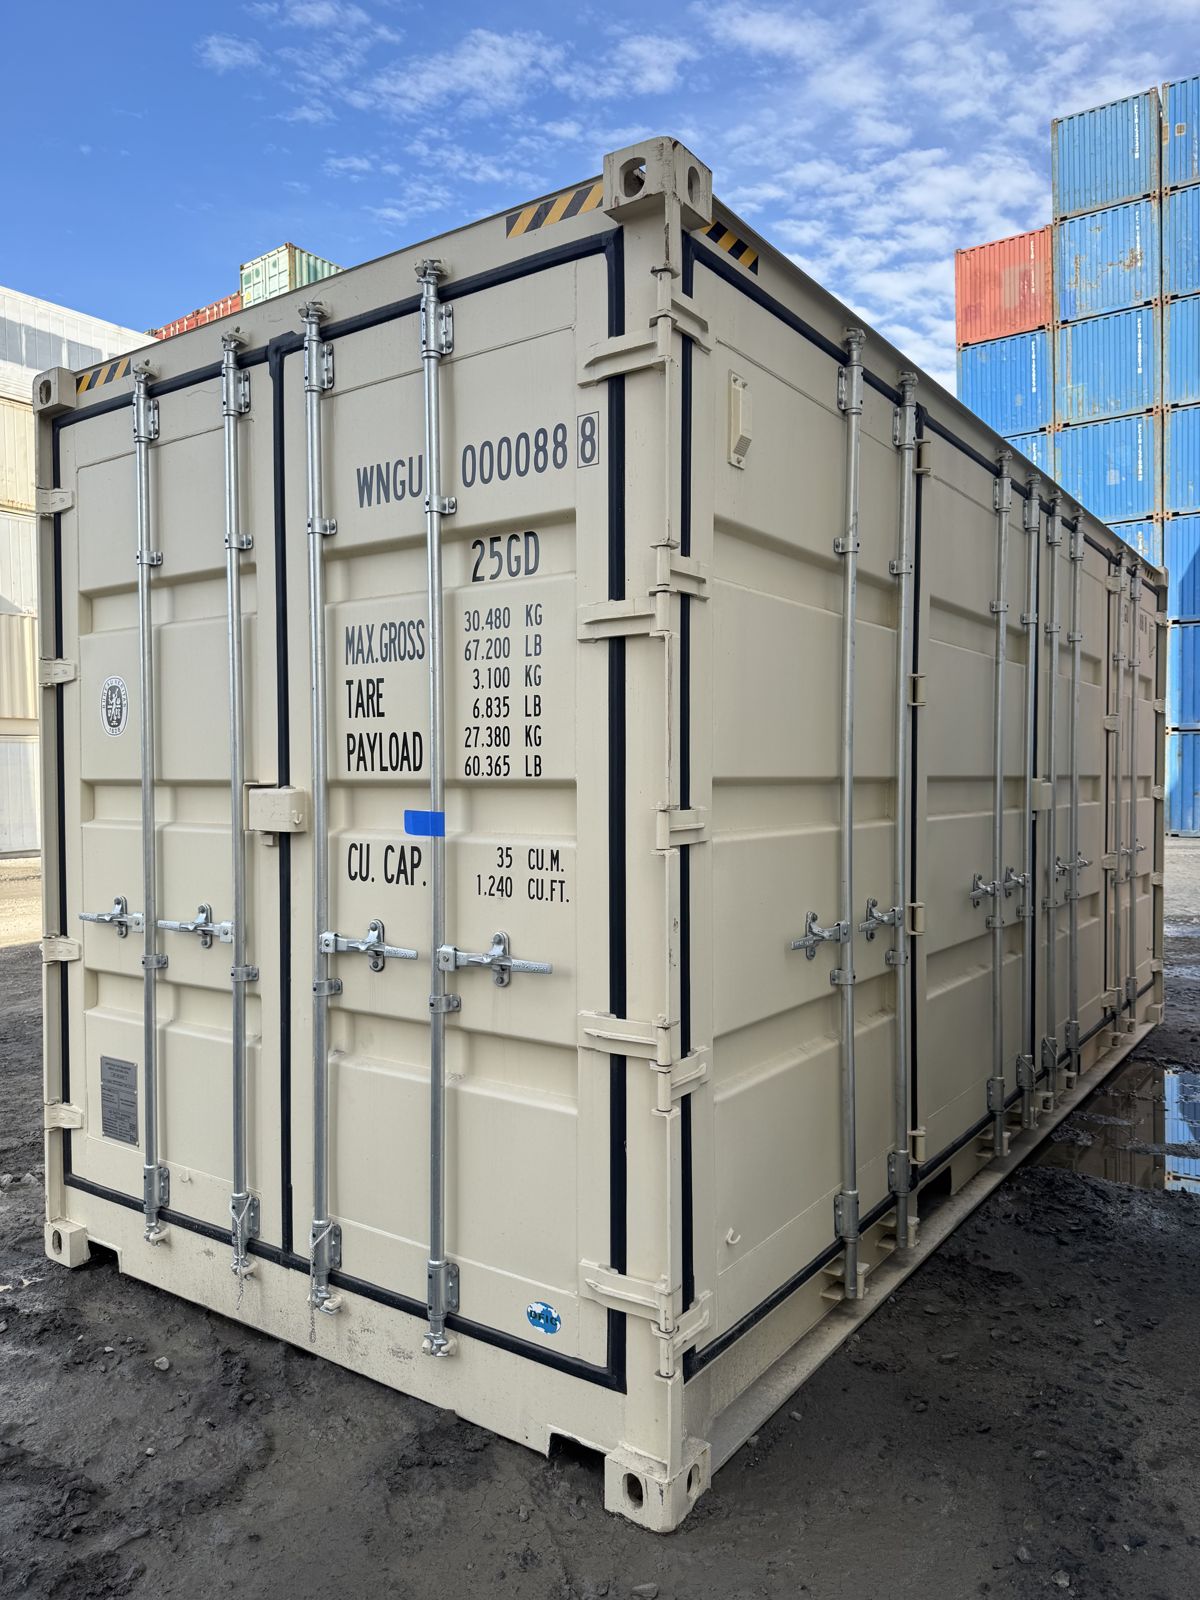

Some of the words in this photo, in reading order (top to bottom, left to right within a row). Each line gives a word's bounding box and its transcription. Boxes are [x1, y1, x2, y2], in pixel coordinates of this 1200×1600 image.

[356, 454, 423, 508] WNGU
[471, 531, 540, 582] 25GD
[345, 619, 425, 665] MAX.GROSS
[525, 603, 543, 627] KG
[525, 634, 542, 657] LB
[345, 677, 385, 718] TARE
[524, 664, 542, 687] KG
[524, 694, 542, 717] LB
[346, 731, 423, 772] PAYLOAD
[525, 724, 542, 747] KG
[525, 754, 542, 777] LB
[348, 842, 375, 882] CU.
[384, 844, 427, 887] CAP.
[496, 846, 513, 869] 35
[528, 848, 564, 872] CU.M.
[528, 878, 570, 903] CU.FT.
